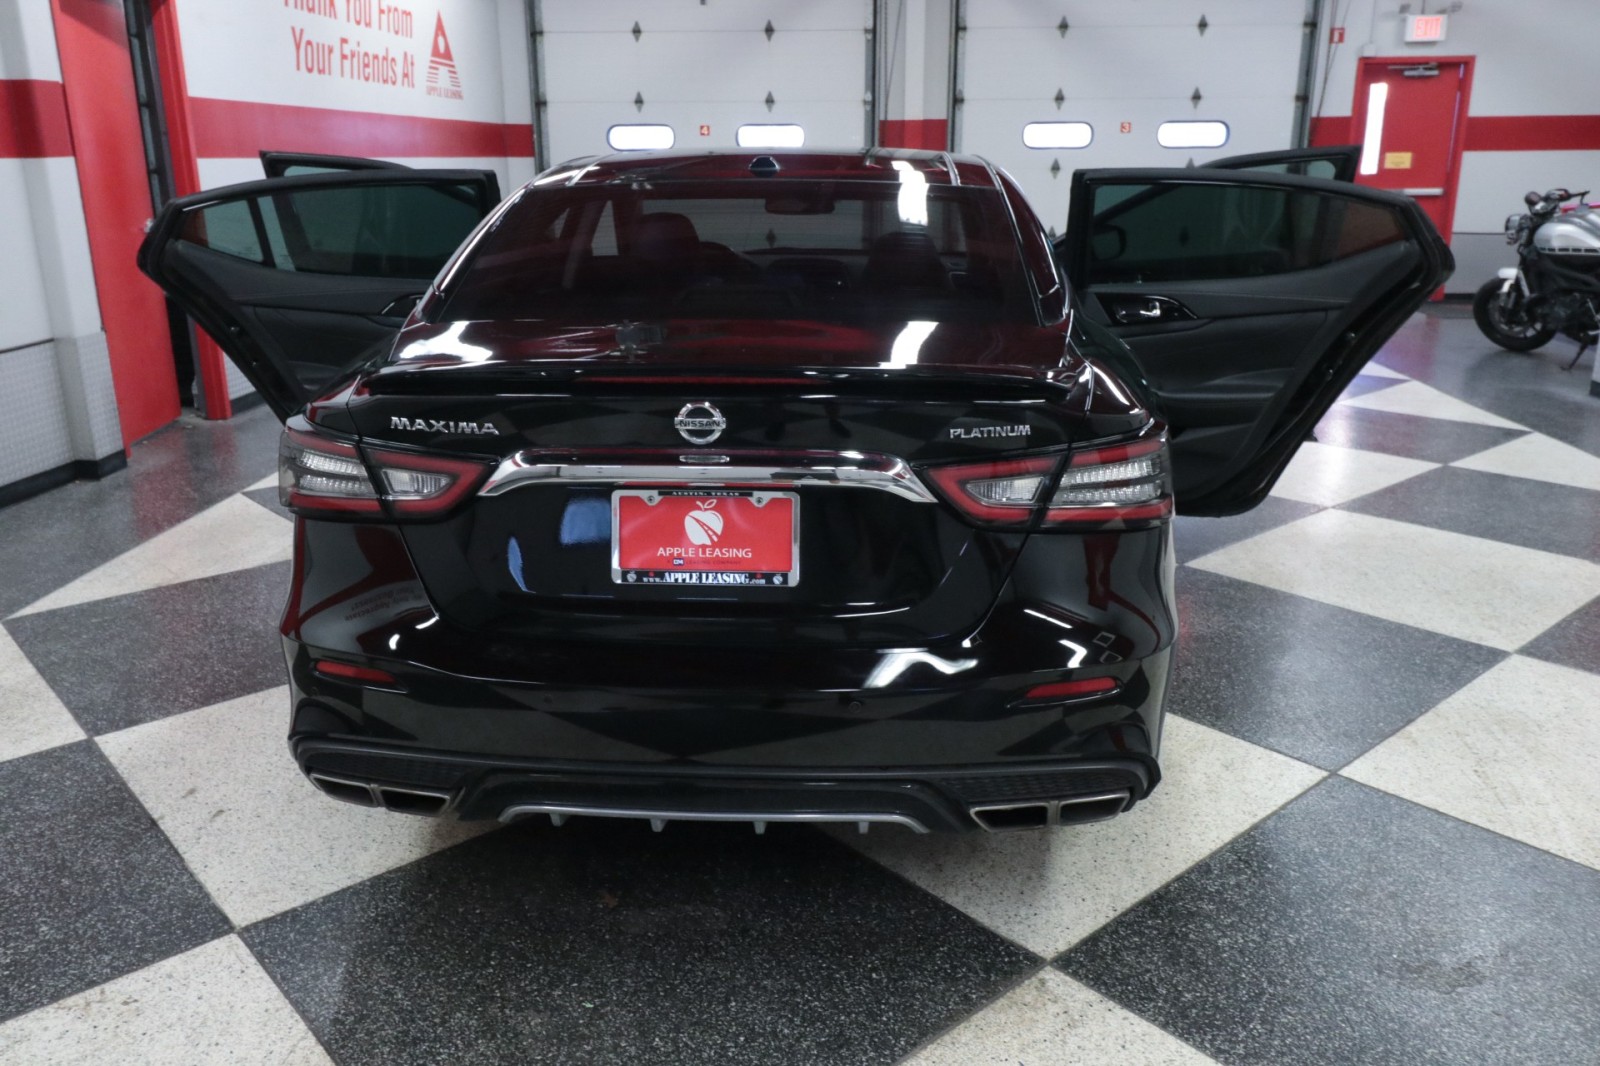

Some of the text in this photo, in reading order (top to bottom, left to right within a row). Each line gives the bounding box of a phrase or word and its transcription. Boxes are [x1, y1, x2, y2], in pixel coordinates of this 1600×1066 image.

[346, 0, 372, 28] You
[378, 0, 413, 39] From
[1414, 17, 1442, 38] EXIT
[291, 25, 416, 89] Your Friends At
[390, 416, 500, 435] MAXIMA
[949, 424, 1031, 439] PLATINUM
[657, 547, 752, 558] APPLE LEASING
